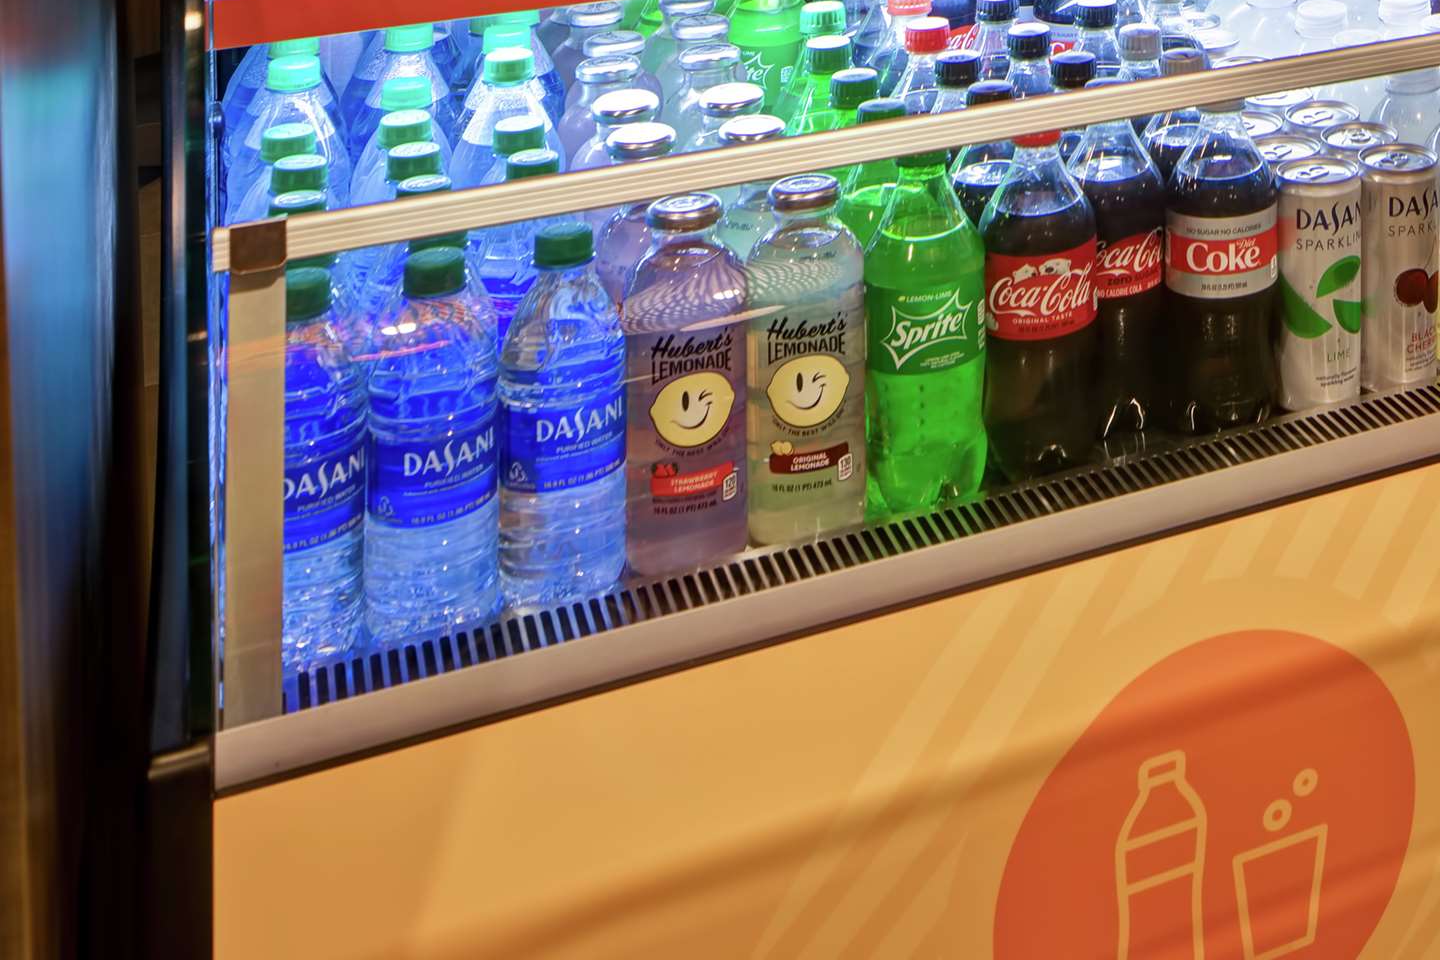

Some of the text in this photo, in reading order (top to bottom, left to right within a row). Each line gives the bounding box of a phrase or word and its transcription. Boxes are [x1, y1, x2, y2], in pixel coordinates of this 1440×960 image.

[1295, 200, 1361, 235] DASAN
[1388, 187, 1439, 221] DASA
[1196, 228, 1220, 236] SUGAR
[1295, 231, 1361, 252] SPARKLIN
[1186, 241, 1260, 273] Coke
[989, 260, 1094, 317] Coca-Cola
[765, 311, 848, 341] Hubert's
[890, 311, 963, 350] Sprite
[1012, 311, 1073, 325] ORIGINAL TASTE
[650, 325, 734, 360] Hubert's
[767, 334, 846, 365] LEMONADE
[1326, 348, 1351, 363] LIME
[650, 349, 732, 385] LEMONADE
[536, 395, 623, 443] DASANI
[787, 428, 800, 436] THE
[403, 428, 495, 478] DASANI
[790, 459, 830, 472] LEMONADE
[792, 452, 827, 464] ORIGINAL
[673, 479, 715, 494] LEMONADE
